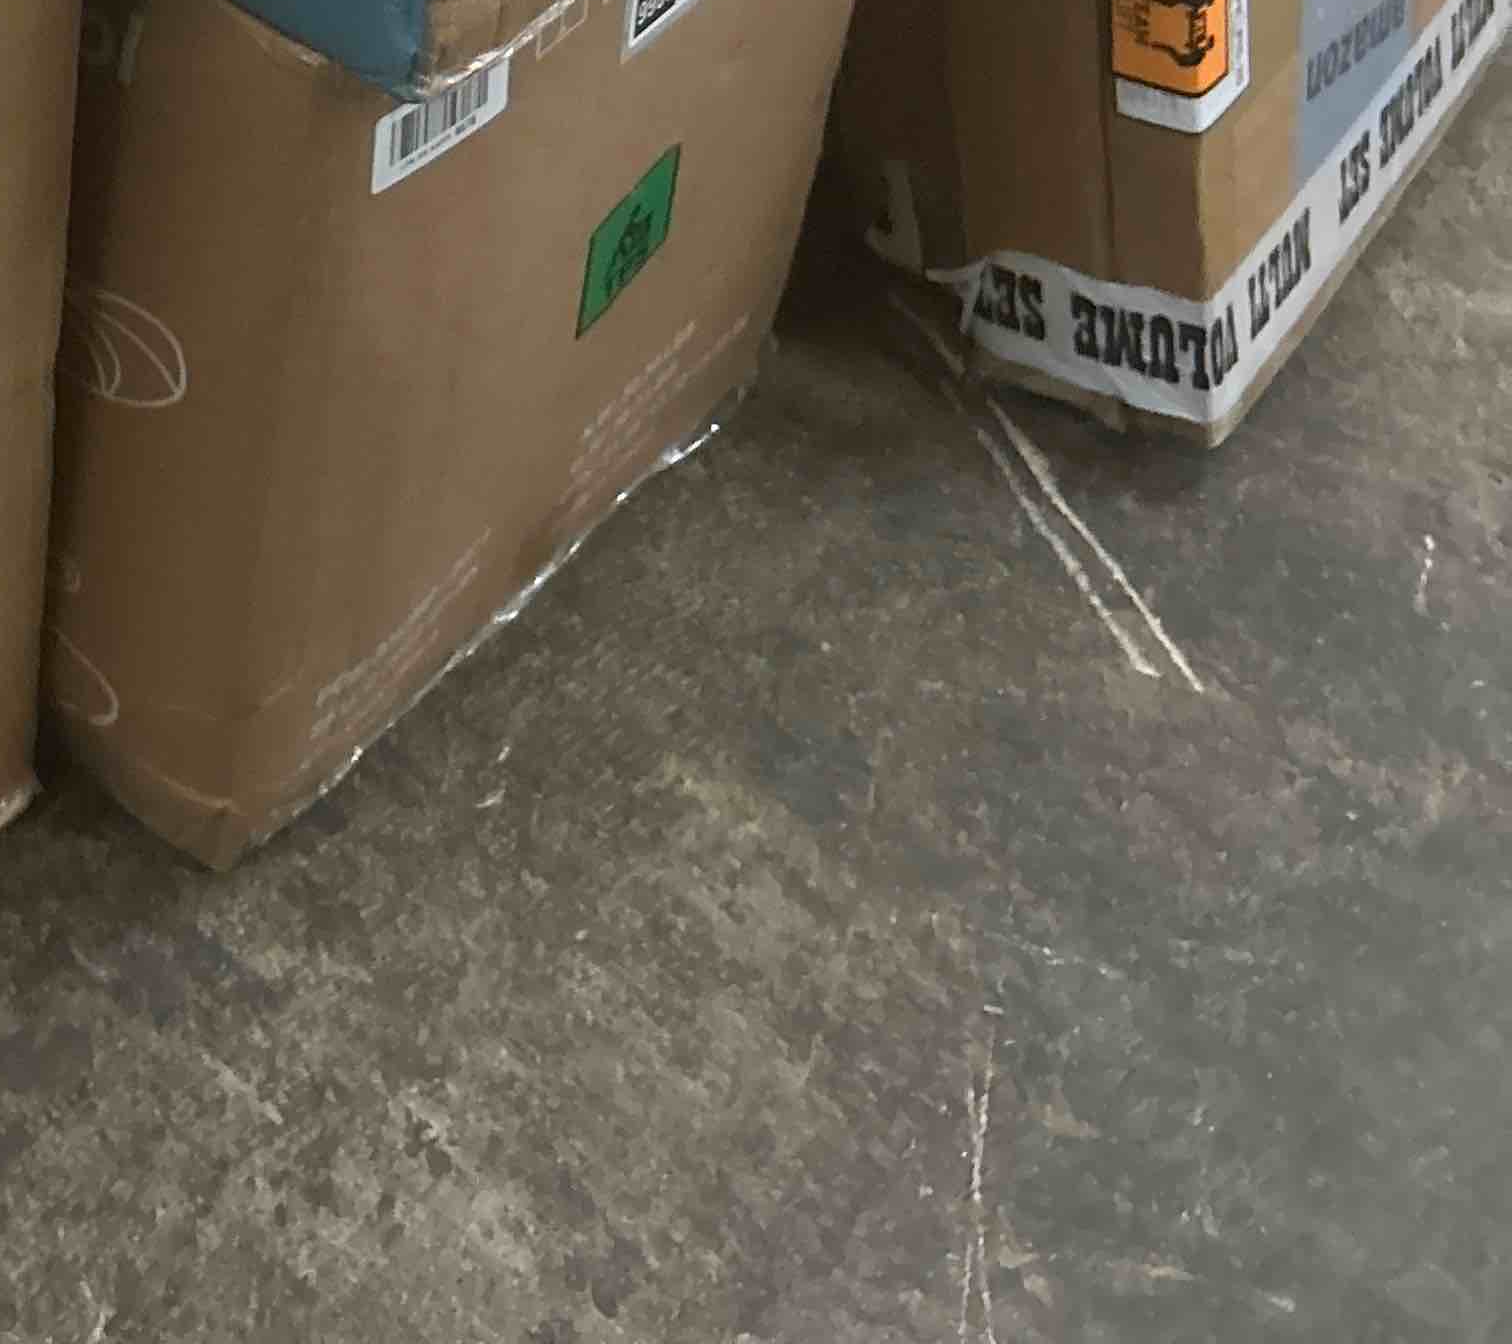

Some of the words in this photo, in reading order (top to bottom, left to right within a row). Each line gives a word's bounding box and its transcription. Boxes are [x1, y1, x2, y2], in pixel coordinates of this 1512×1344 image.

[1337, 130, 1372, 225] SET
[972, 262, 1046, 342] SET
[1247, 208, 1313, 342] MULTI
[1070, 290, 1240, 391] VOLUME
